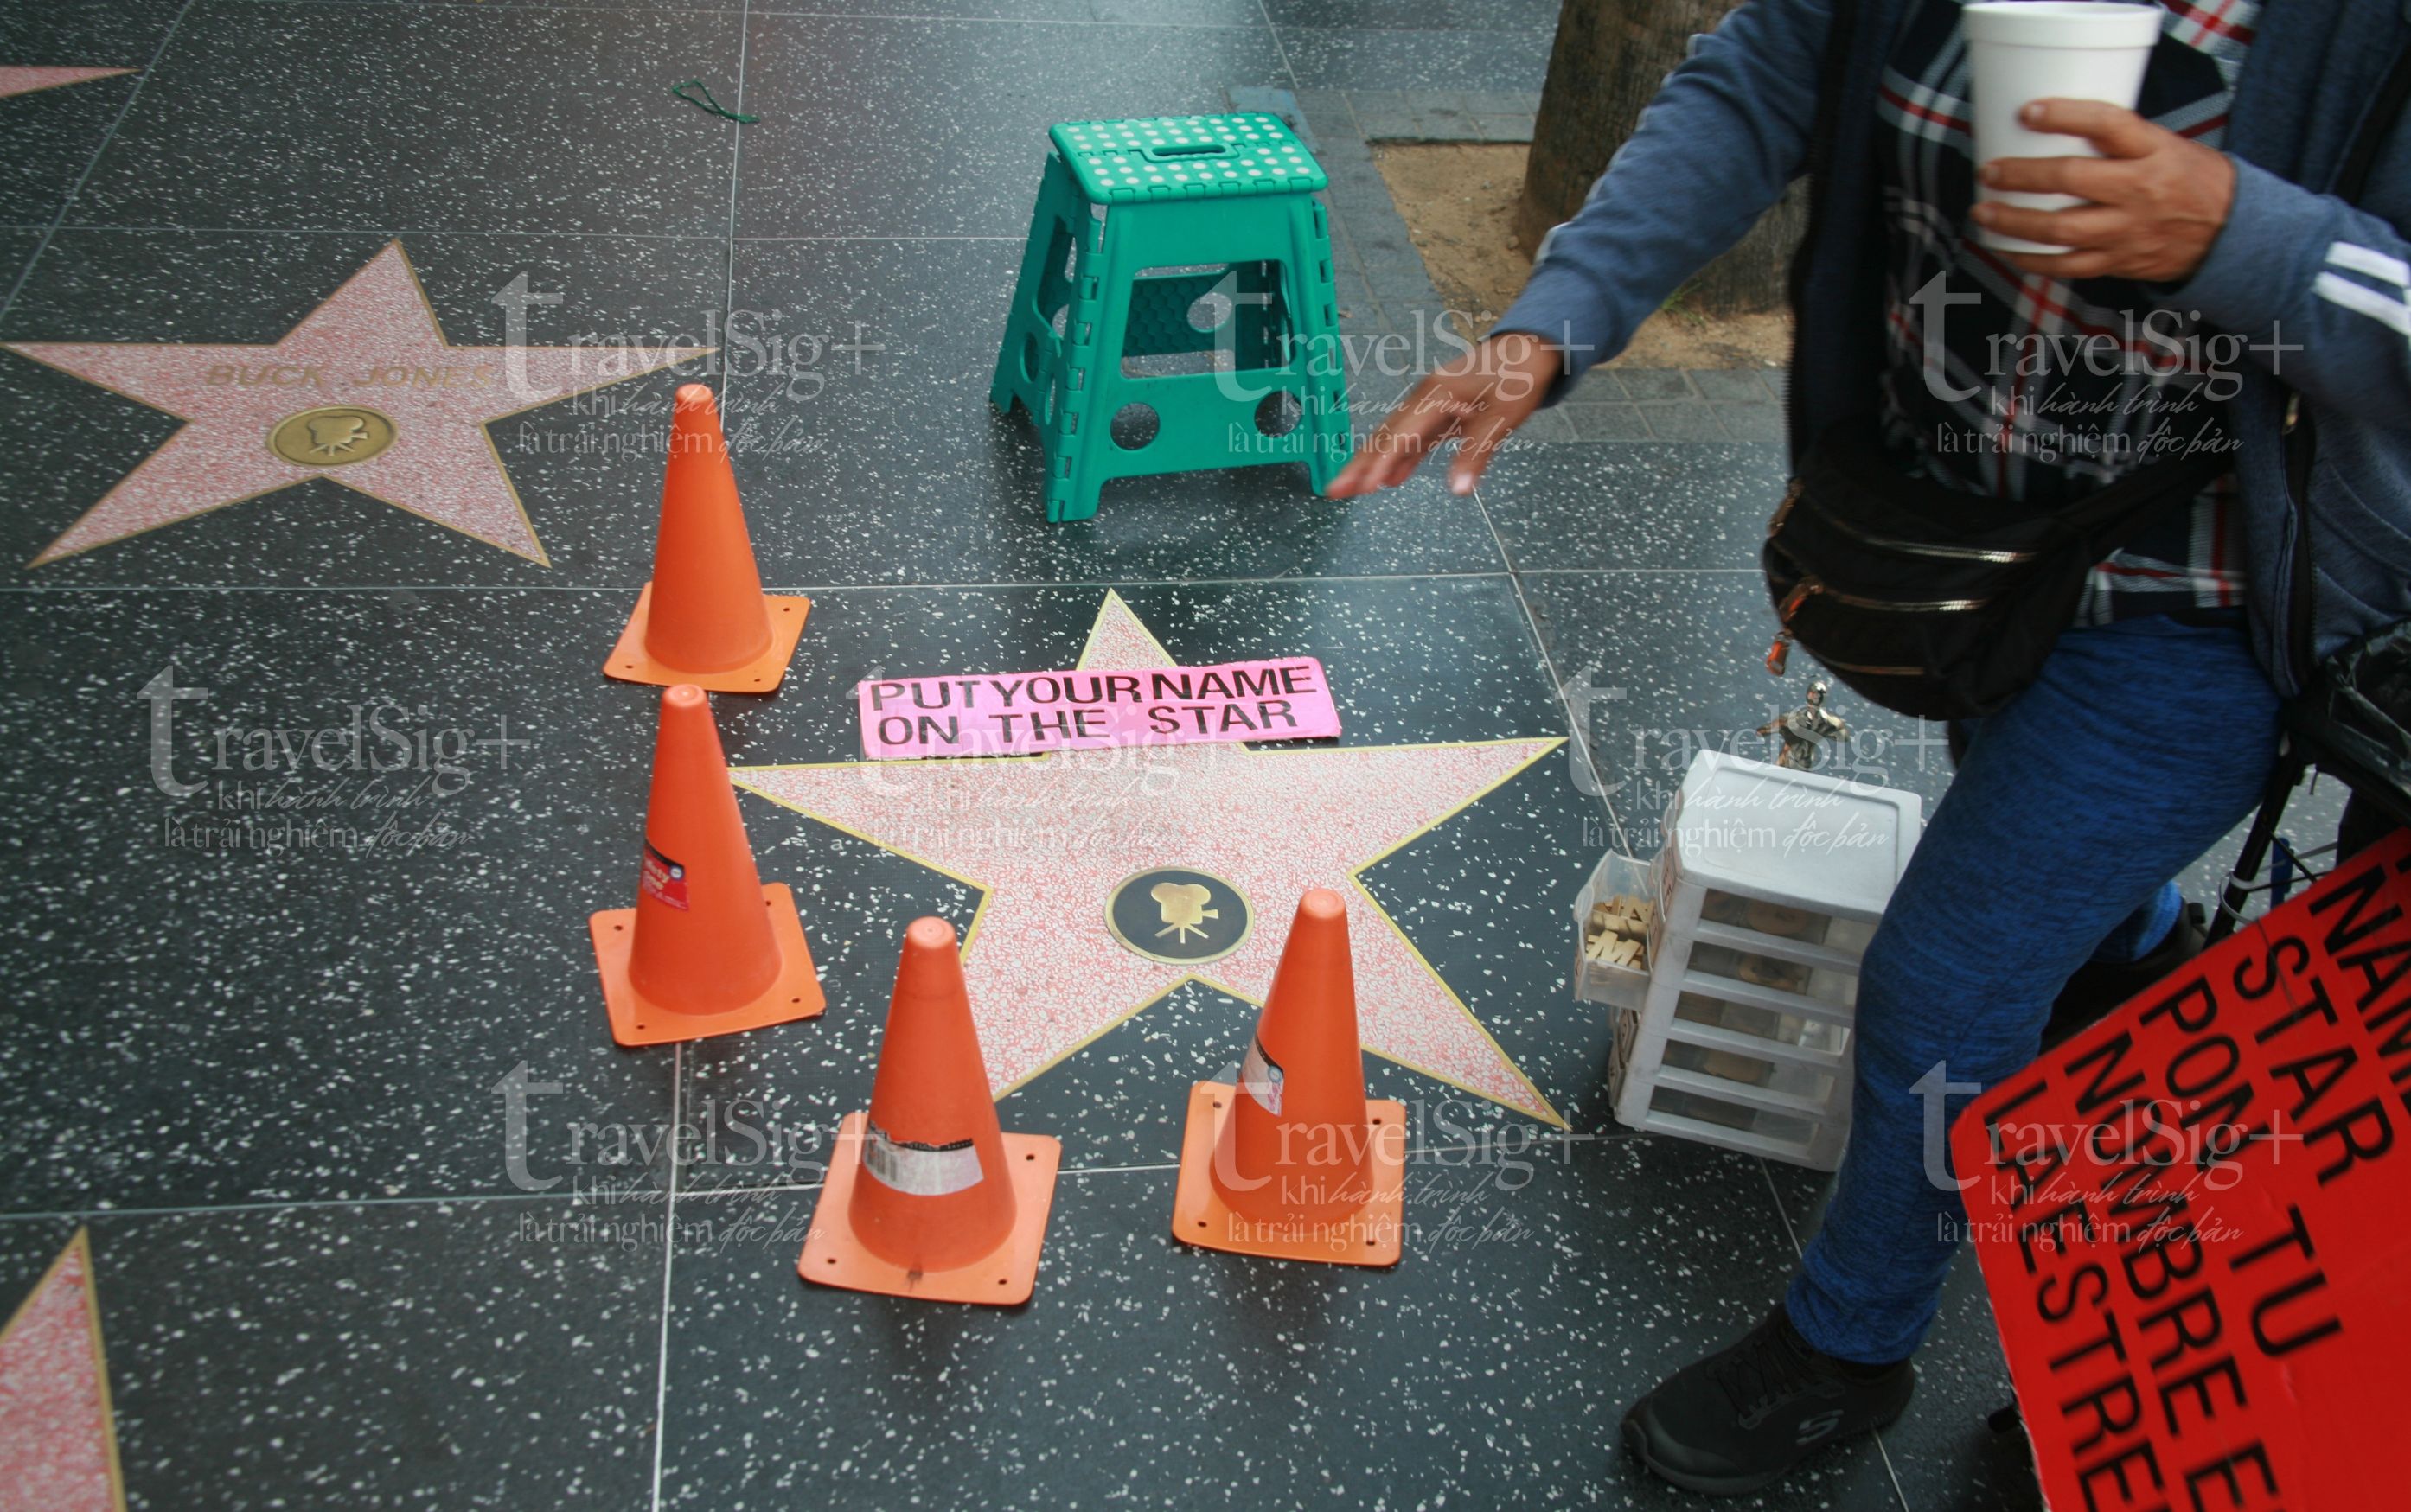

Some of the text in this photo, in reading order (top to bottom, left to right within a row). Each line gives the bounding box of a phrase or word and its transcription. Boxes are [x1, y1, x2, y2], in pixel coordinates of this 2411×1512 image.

[206, 365, 494, 389] BUCK JONES
[871, 665, 1318, 711] PUT YOUR NAME
[877, 699, 1298, 746] ON THE STAR
[2233, 935, 2394, 1187] STAR
[2064, 1029, 2248, 1437] NOMBRE
[2139, 974, 2344, 1356] PON TU
